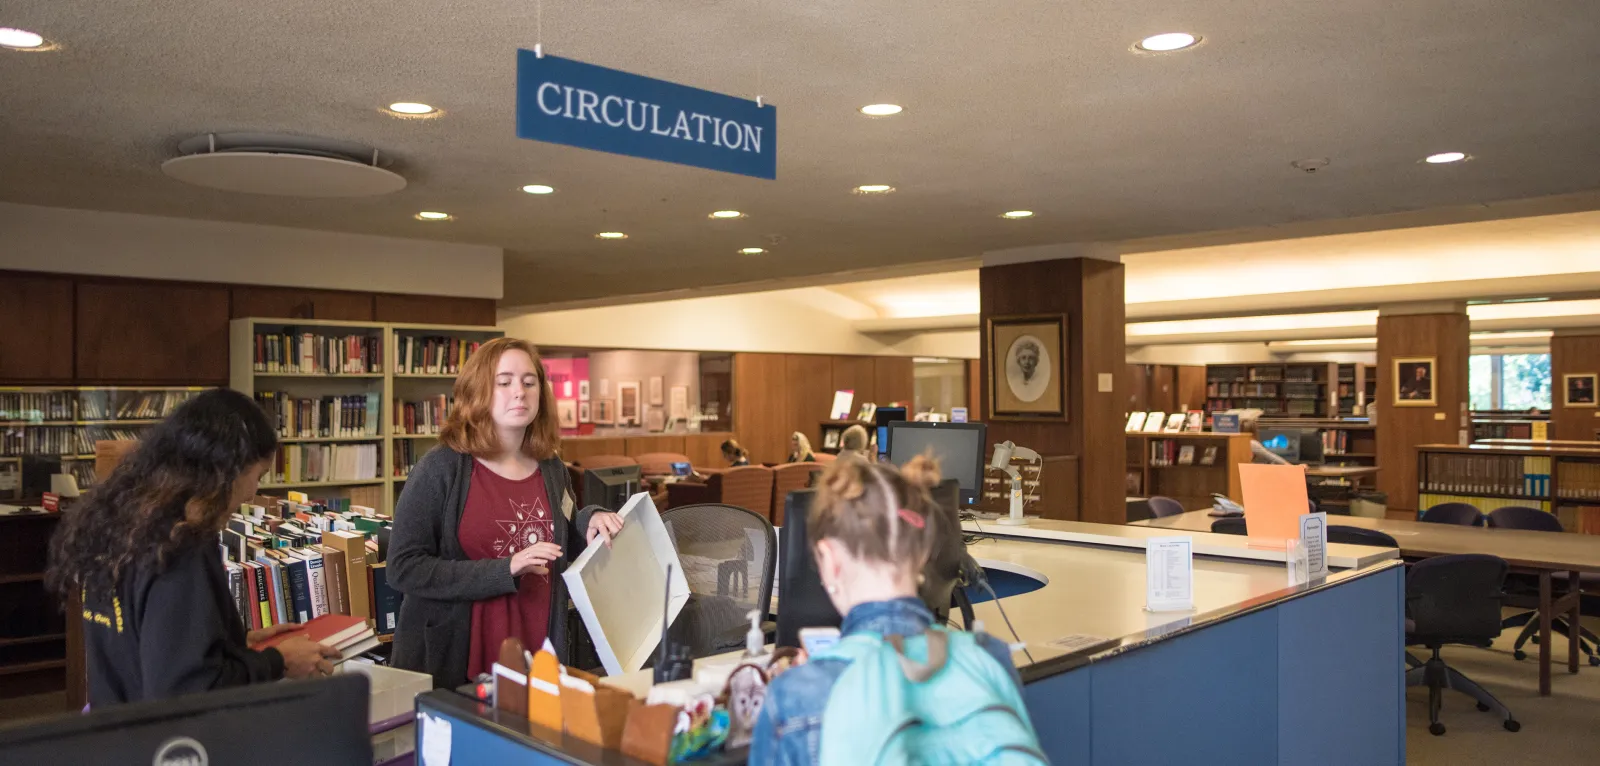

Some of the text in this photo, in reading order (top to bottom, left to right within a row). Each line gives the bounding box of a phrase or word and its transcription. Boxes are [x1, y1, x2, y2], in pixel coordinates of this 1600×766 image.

[537, 82, 763, 153] CIRCULATION
[257, 567, 266, 601] STRUCTURE
[312, 571, 321, 603] Qualitative
